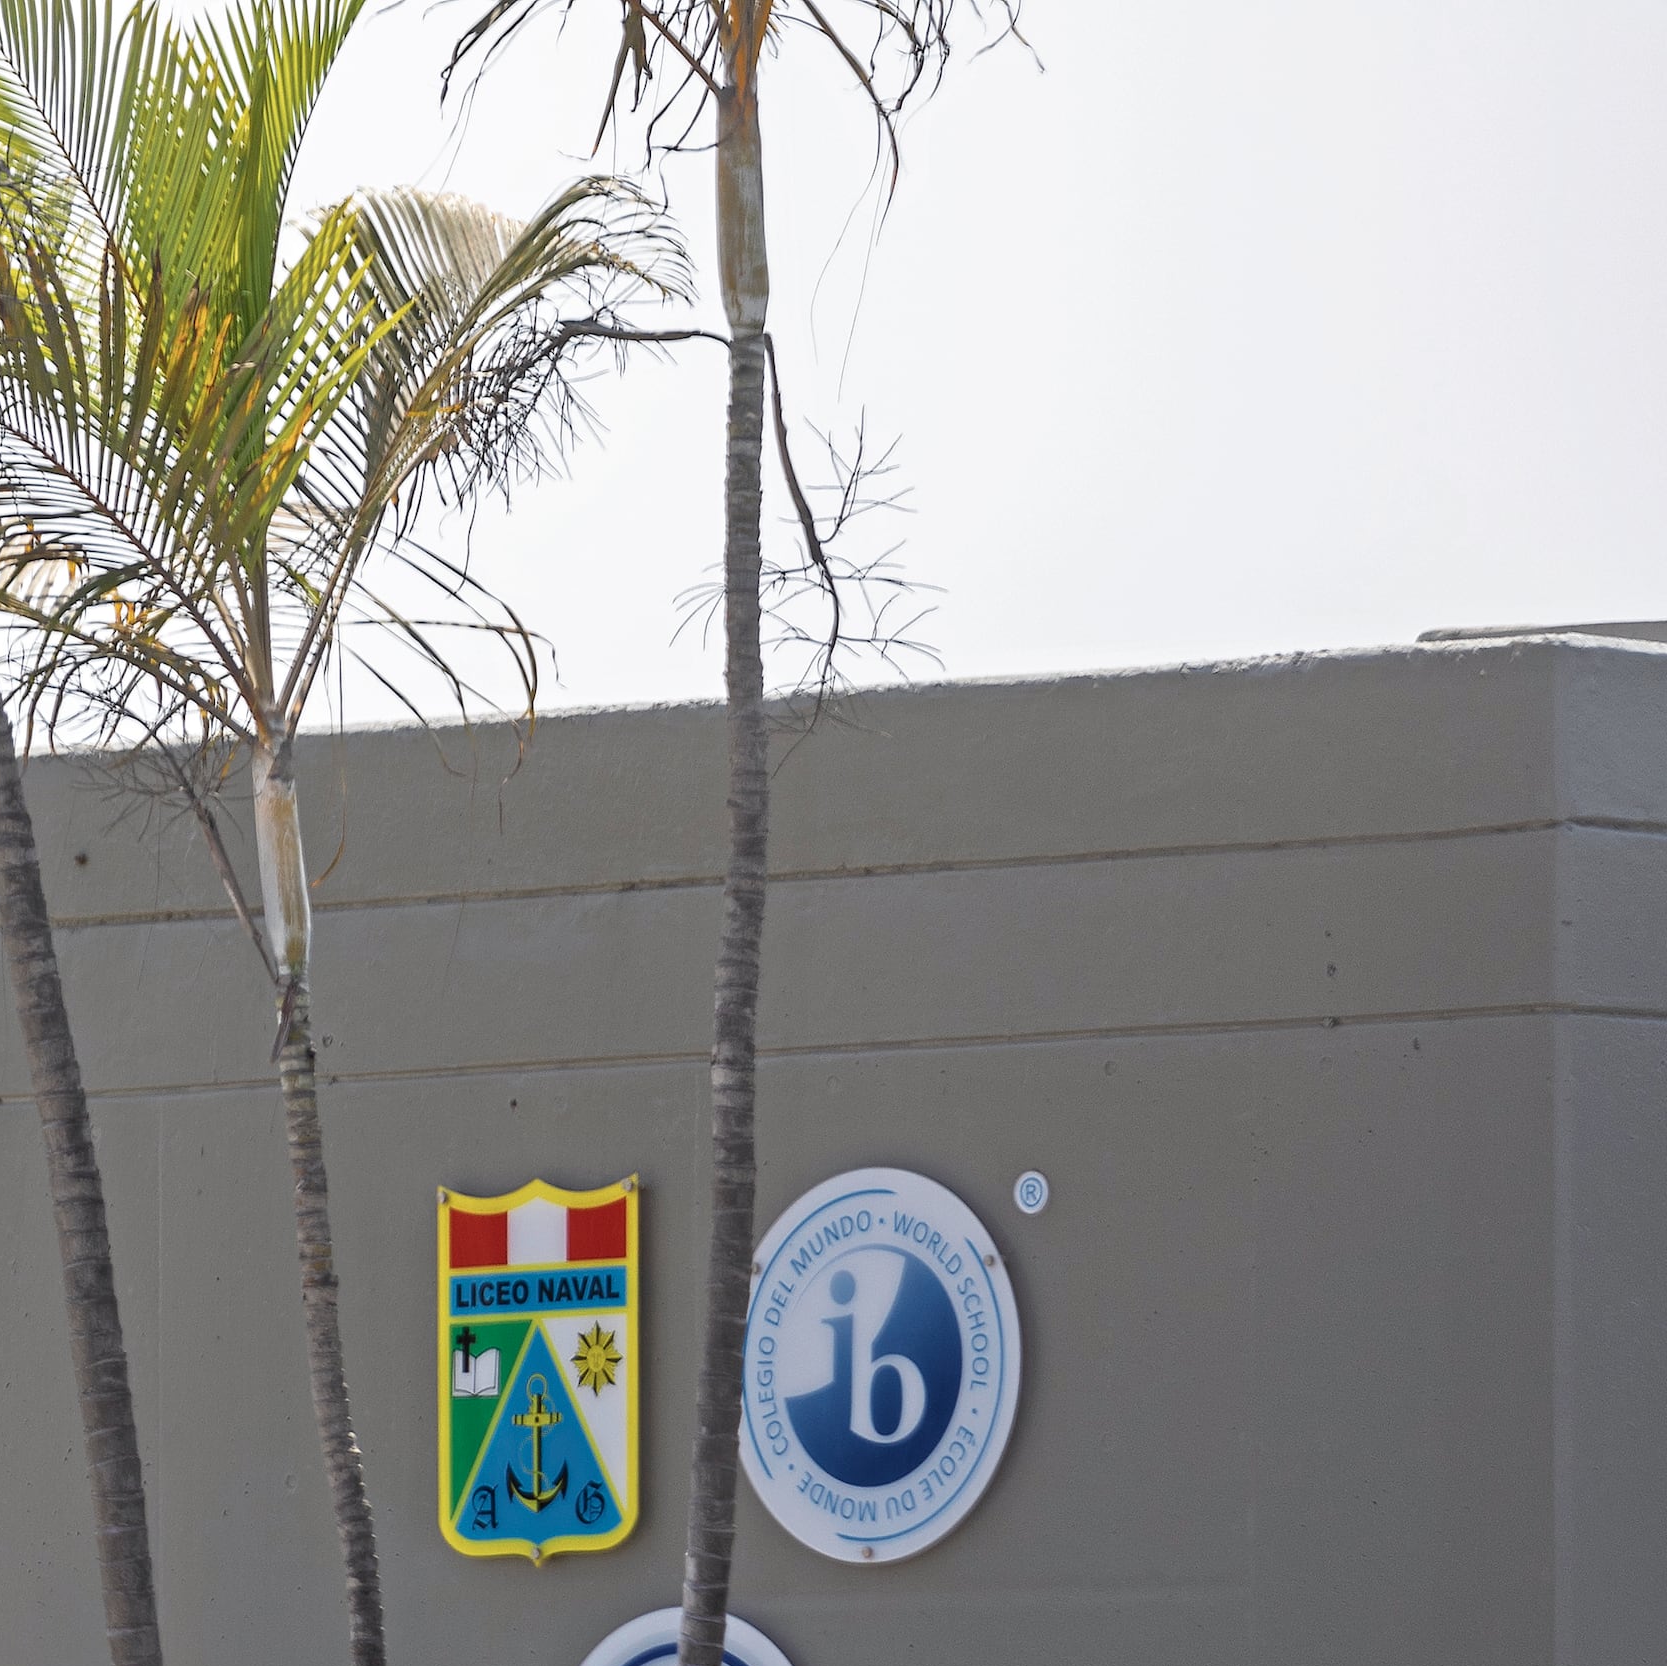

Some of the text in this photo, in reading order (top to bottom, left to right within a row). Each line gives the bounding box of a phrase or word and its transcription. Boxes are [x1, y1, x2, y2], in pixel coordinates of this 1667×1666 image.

[455, 1273, 620, 1309] LICEO NAVAL
[757, 1210, 872, 1457] COLEGIO DEL MUNDO
[893, 1210, 990, 1391] WORLD SCHOOL
[796, 1424, 977, 1522] ÉCOLE DU MONDE
